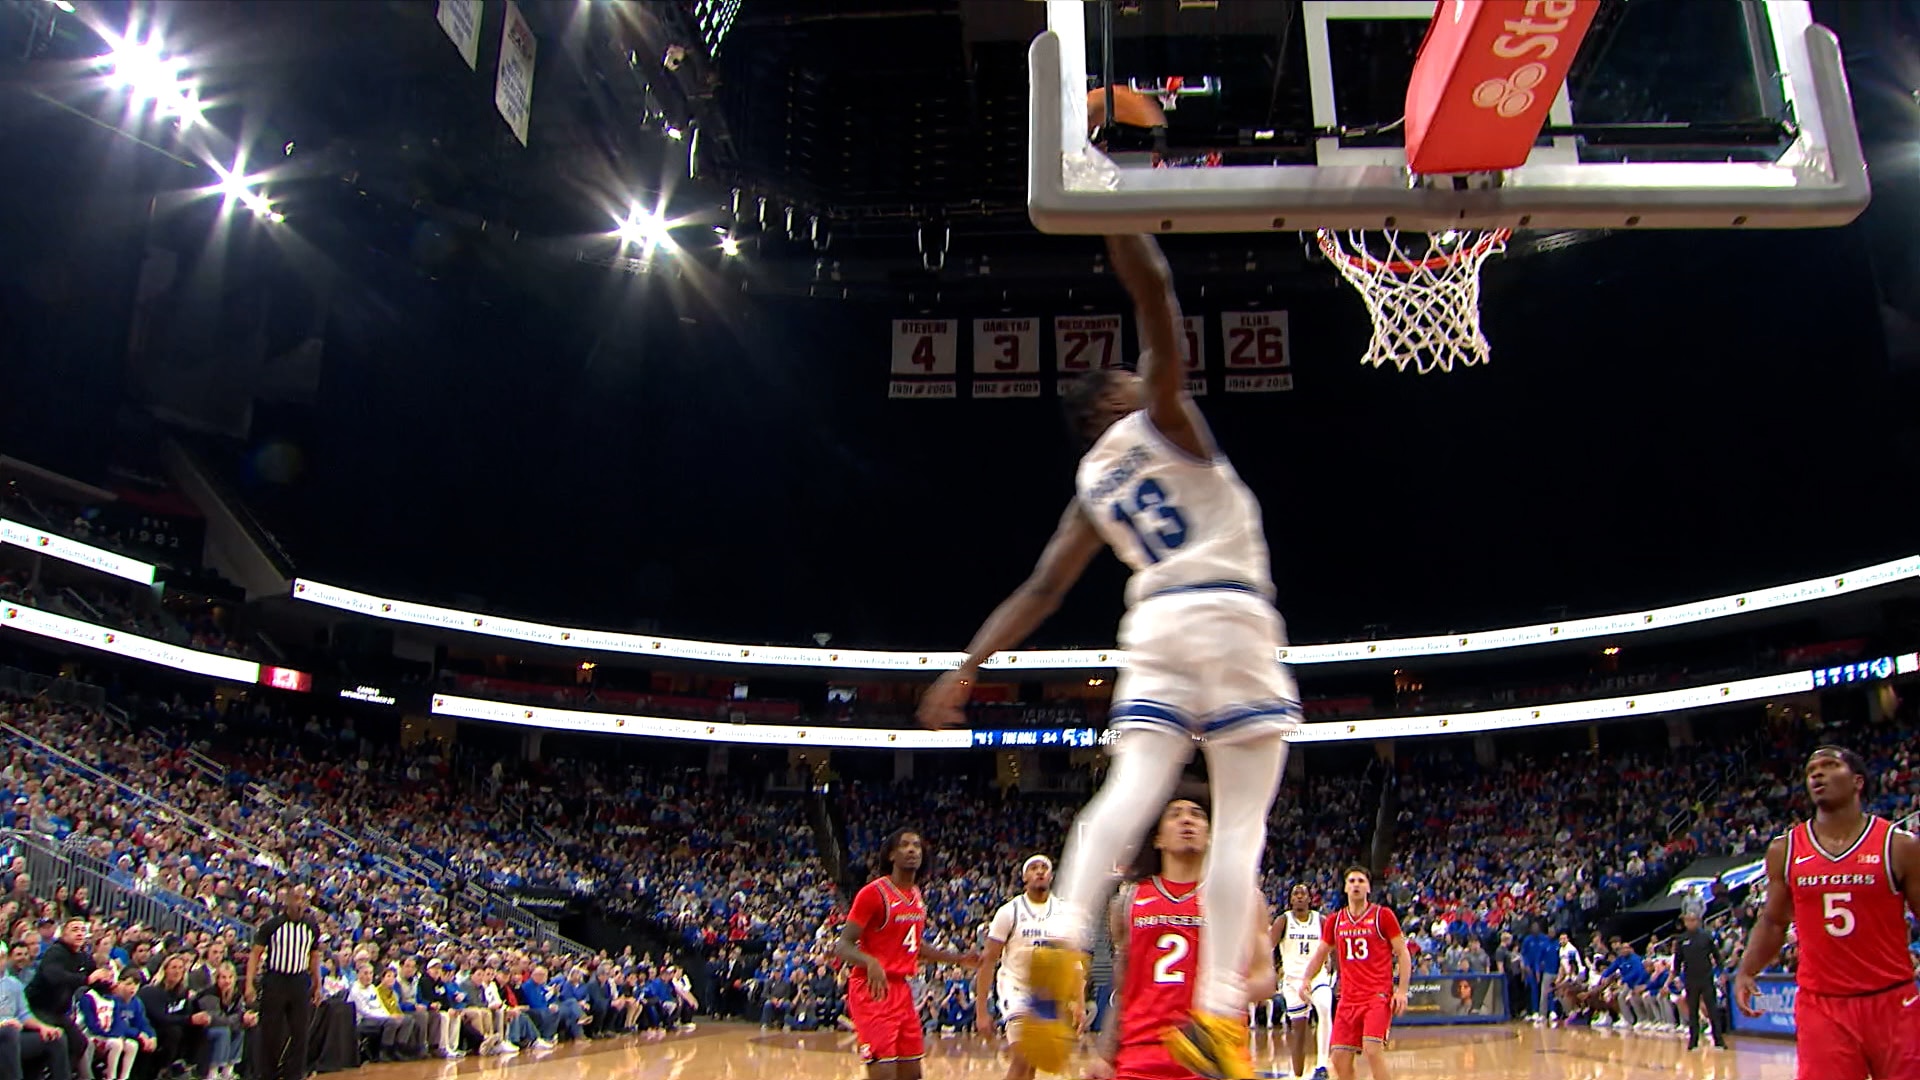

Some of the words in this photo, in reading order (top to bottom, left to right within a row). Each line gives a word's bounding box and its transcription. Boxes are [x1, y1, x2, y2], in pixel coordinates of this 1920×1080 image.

[1240, 316, 1270, 326] ELIAS
[912, 336, 935, 371] 4
[994, 335, 1019, 370] 3
[1063, 332, 1114, 368] 27
[1229, 327, 1283, 365] 26
[1112, 478, 1187, 564] 13
[1797, 874, 1875, 887] RUTGERS
[1823, 892, 1856, 937] 5
[902, 924, 918, 953] 4
[1299, 941, 1310, 955] 14
[1345, 938, 1369, 961] 13
[1154, 933, 1190, 984] 2
